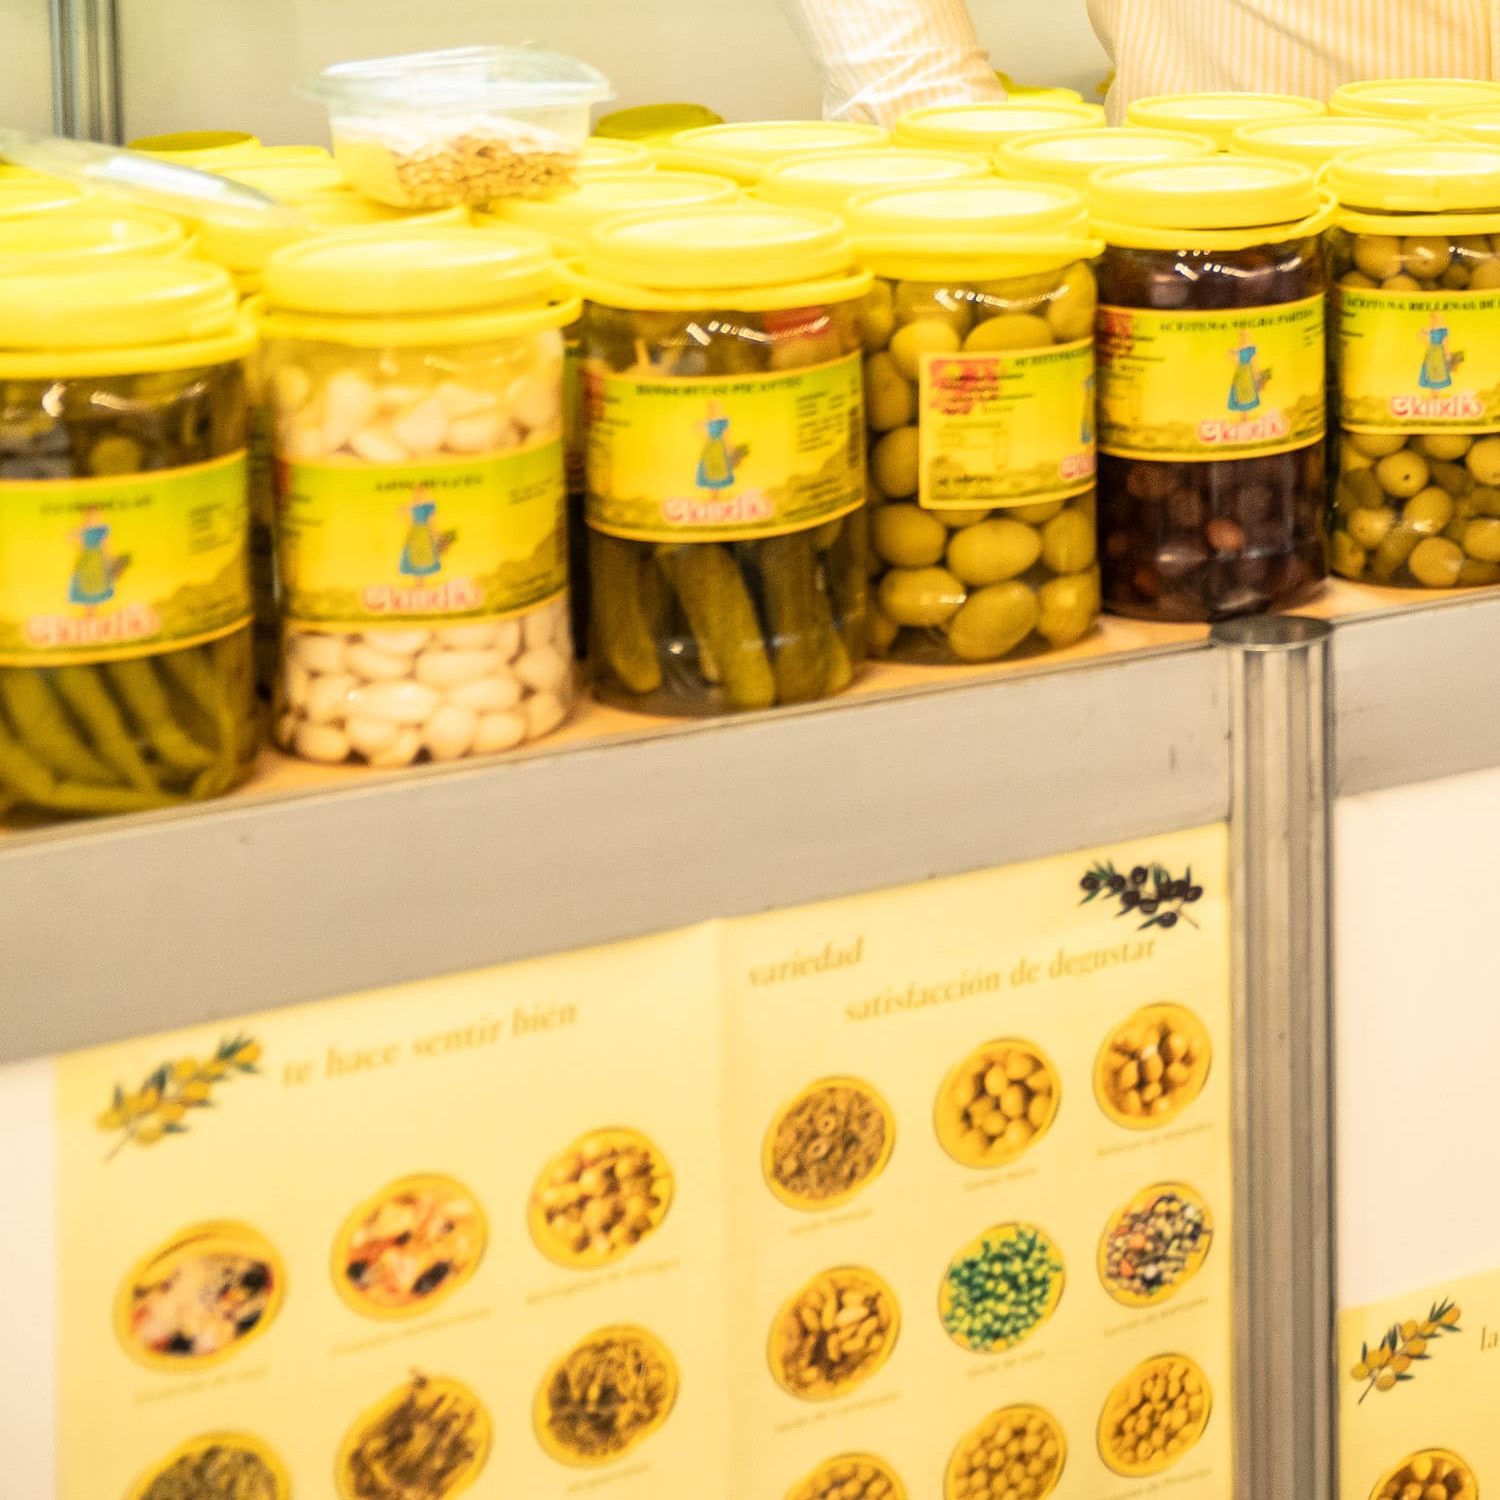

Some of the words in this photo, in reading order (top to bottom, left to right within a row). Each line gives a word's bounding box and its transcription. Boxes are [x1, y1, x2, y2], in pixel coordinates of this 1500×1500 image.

[749, 936, 865, 988] variedad
[843, 968, 1002, 1022] satisfacción
[1008, 956, 1042, 988] de
[1046, 936, 1157, 982] degustar
[281, 1061, 313, 1089] te
[325, 1043, 400, 1079] hace
[411, 1017, 504, 1058] sentir
[512, 1002, 578, 1036] bien
[1480, 1325, 1499, 1351] la
